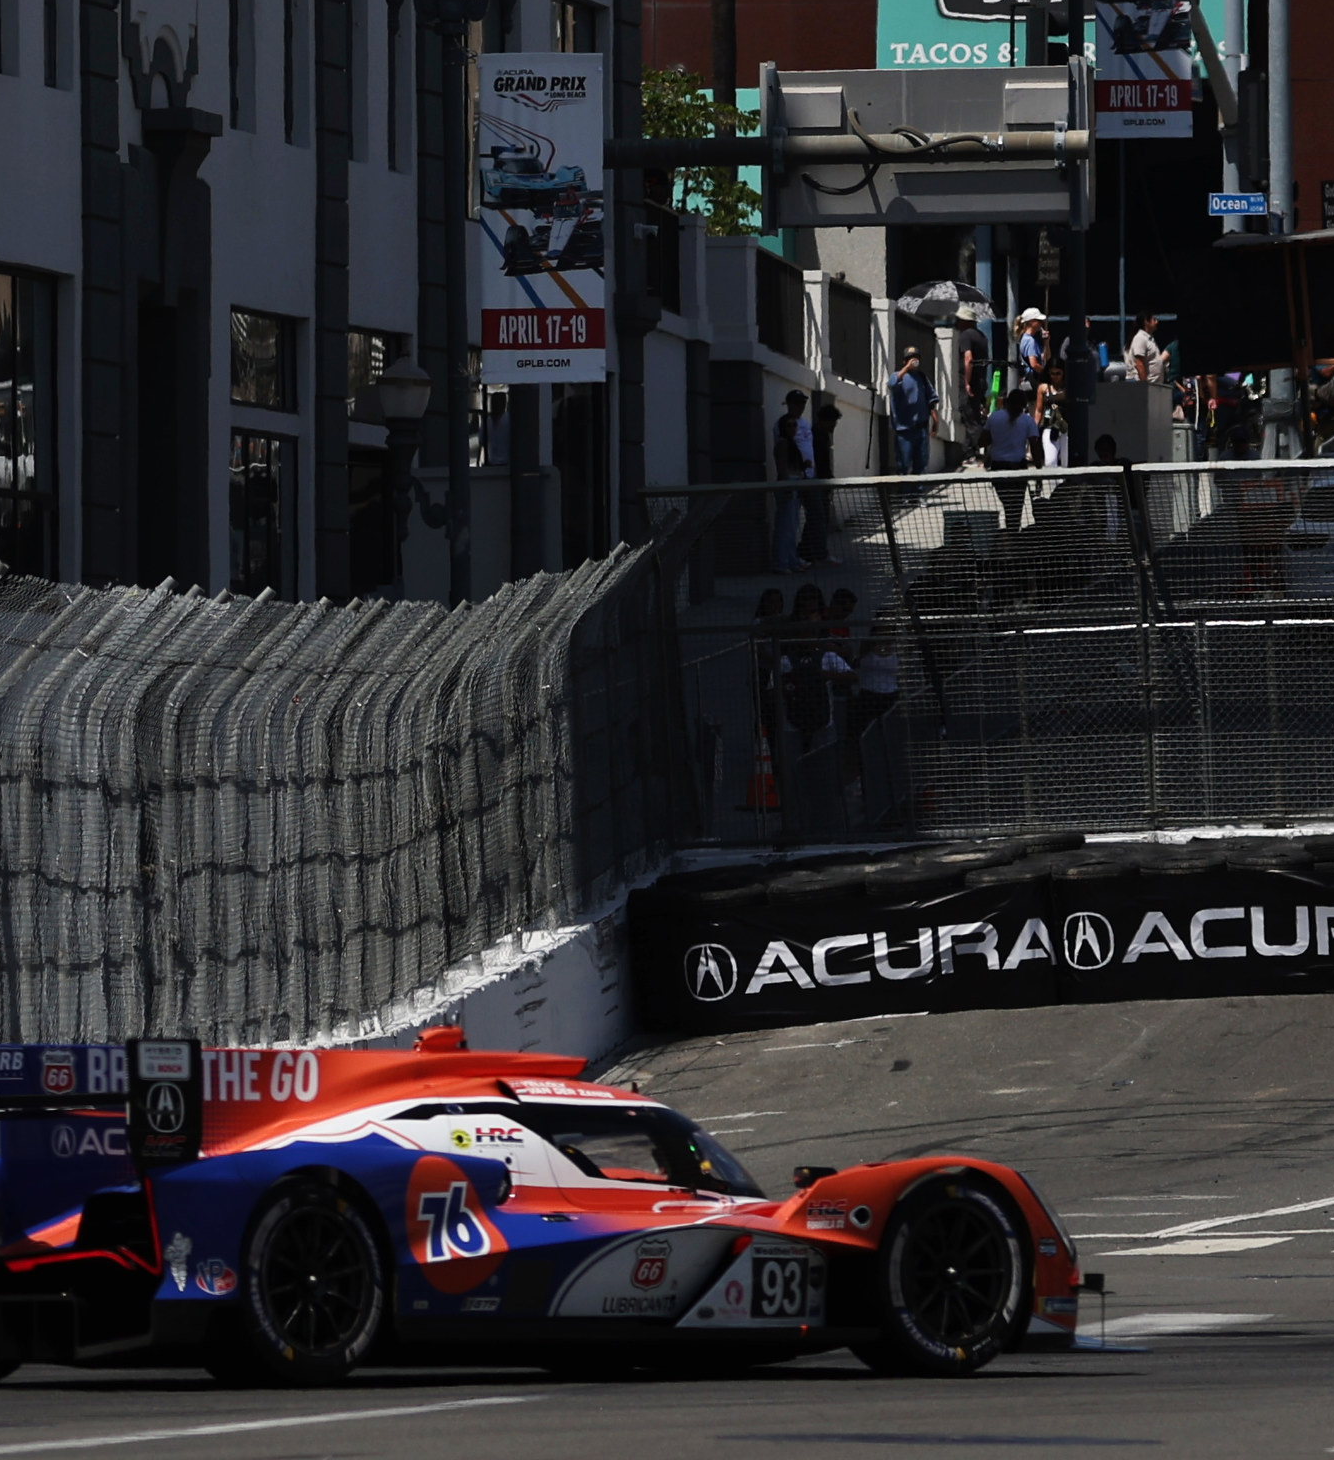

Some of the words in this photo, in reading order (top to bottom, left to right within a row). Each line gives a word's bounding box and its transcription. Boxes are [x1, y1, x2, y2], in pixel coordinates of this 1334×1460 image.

[890, 42, 988, 64] TACOS
[493, 76, 547, 92] GRAND
[550, 76, 586, 91] PRIX
[1109, 85, 1143, 107] APRIL
[1146, 84, 1179, 107] 17-19
[1212, 197, 1248, 210] Ocean
[498, 315, 542, 344] APRIL
[546, 315, 587, 344] 17-19
[516, 358, 571, 369] GPLB.COM
[744, 916, 1056, 995] ACURA
[47, 1068, 69, 1087] 66
[201, 1051, 262, 1102] THE
[270, 1051, 319, 1103] GO
[475, 1127, 524, 1143] HRC
[807, 1199, 847, 1216] HRC
[417, 1181, 491, 1263] 76
[636, 1261, 660, 1280] 66
[761, 1260, 802, 1316] 93
[602, 1294, 677, 1315] LUBRICANTS
